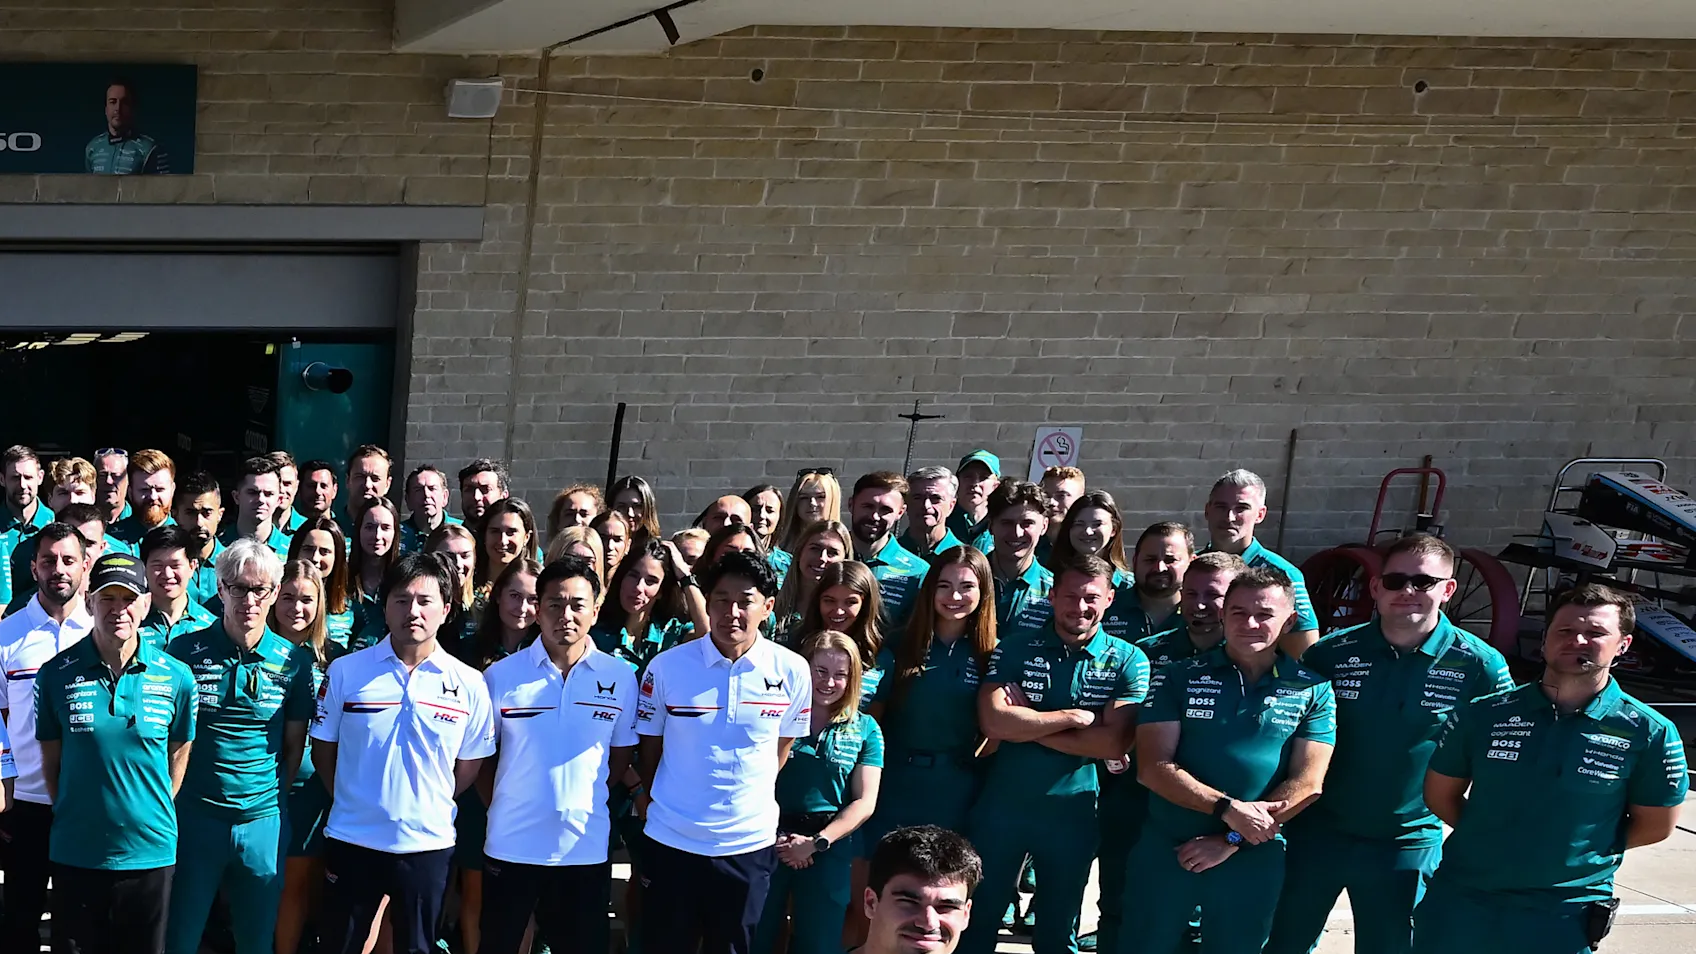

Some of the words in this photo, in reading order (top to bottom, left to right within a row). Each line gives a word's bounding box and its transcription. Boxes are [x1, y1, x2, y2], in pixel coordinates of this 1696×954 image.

[1429, 669, 1465, 680] aramco
[1336, 680, 1362, 688] BOSS
[1189, 697, 1215, 706] BOSS
[70, 702, 93, 711] BOSS
[434, 712, 459, 723] HRC
[592, 710, 616, 720] HRC
[760, 709, 784, 717] HRC
[1492, 740, 1522, 749] BOSS
[1590, 734, 1631, 749] aramco
